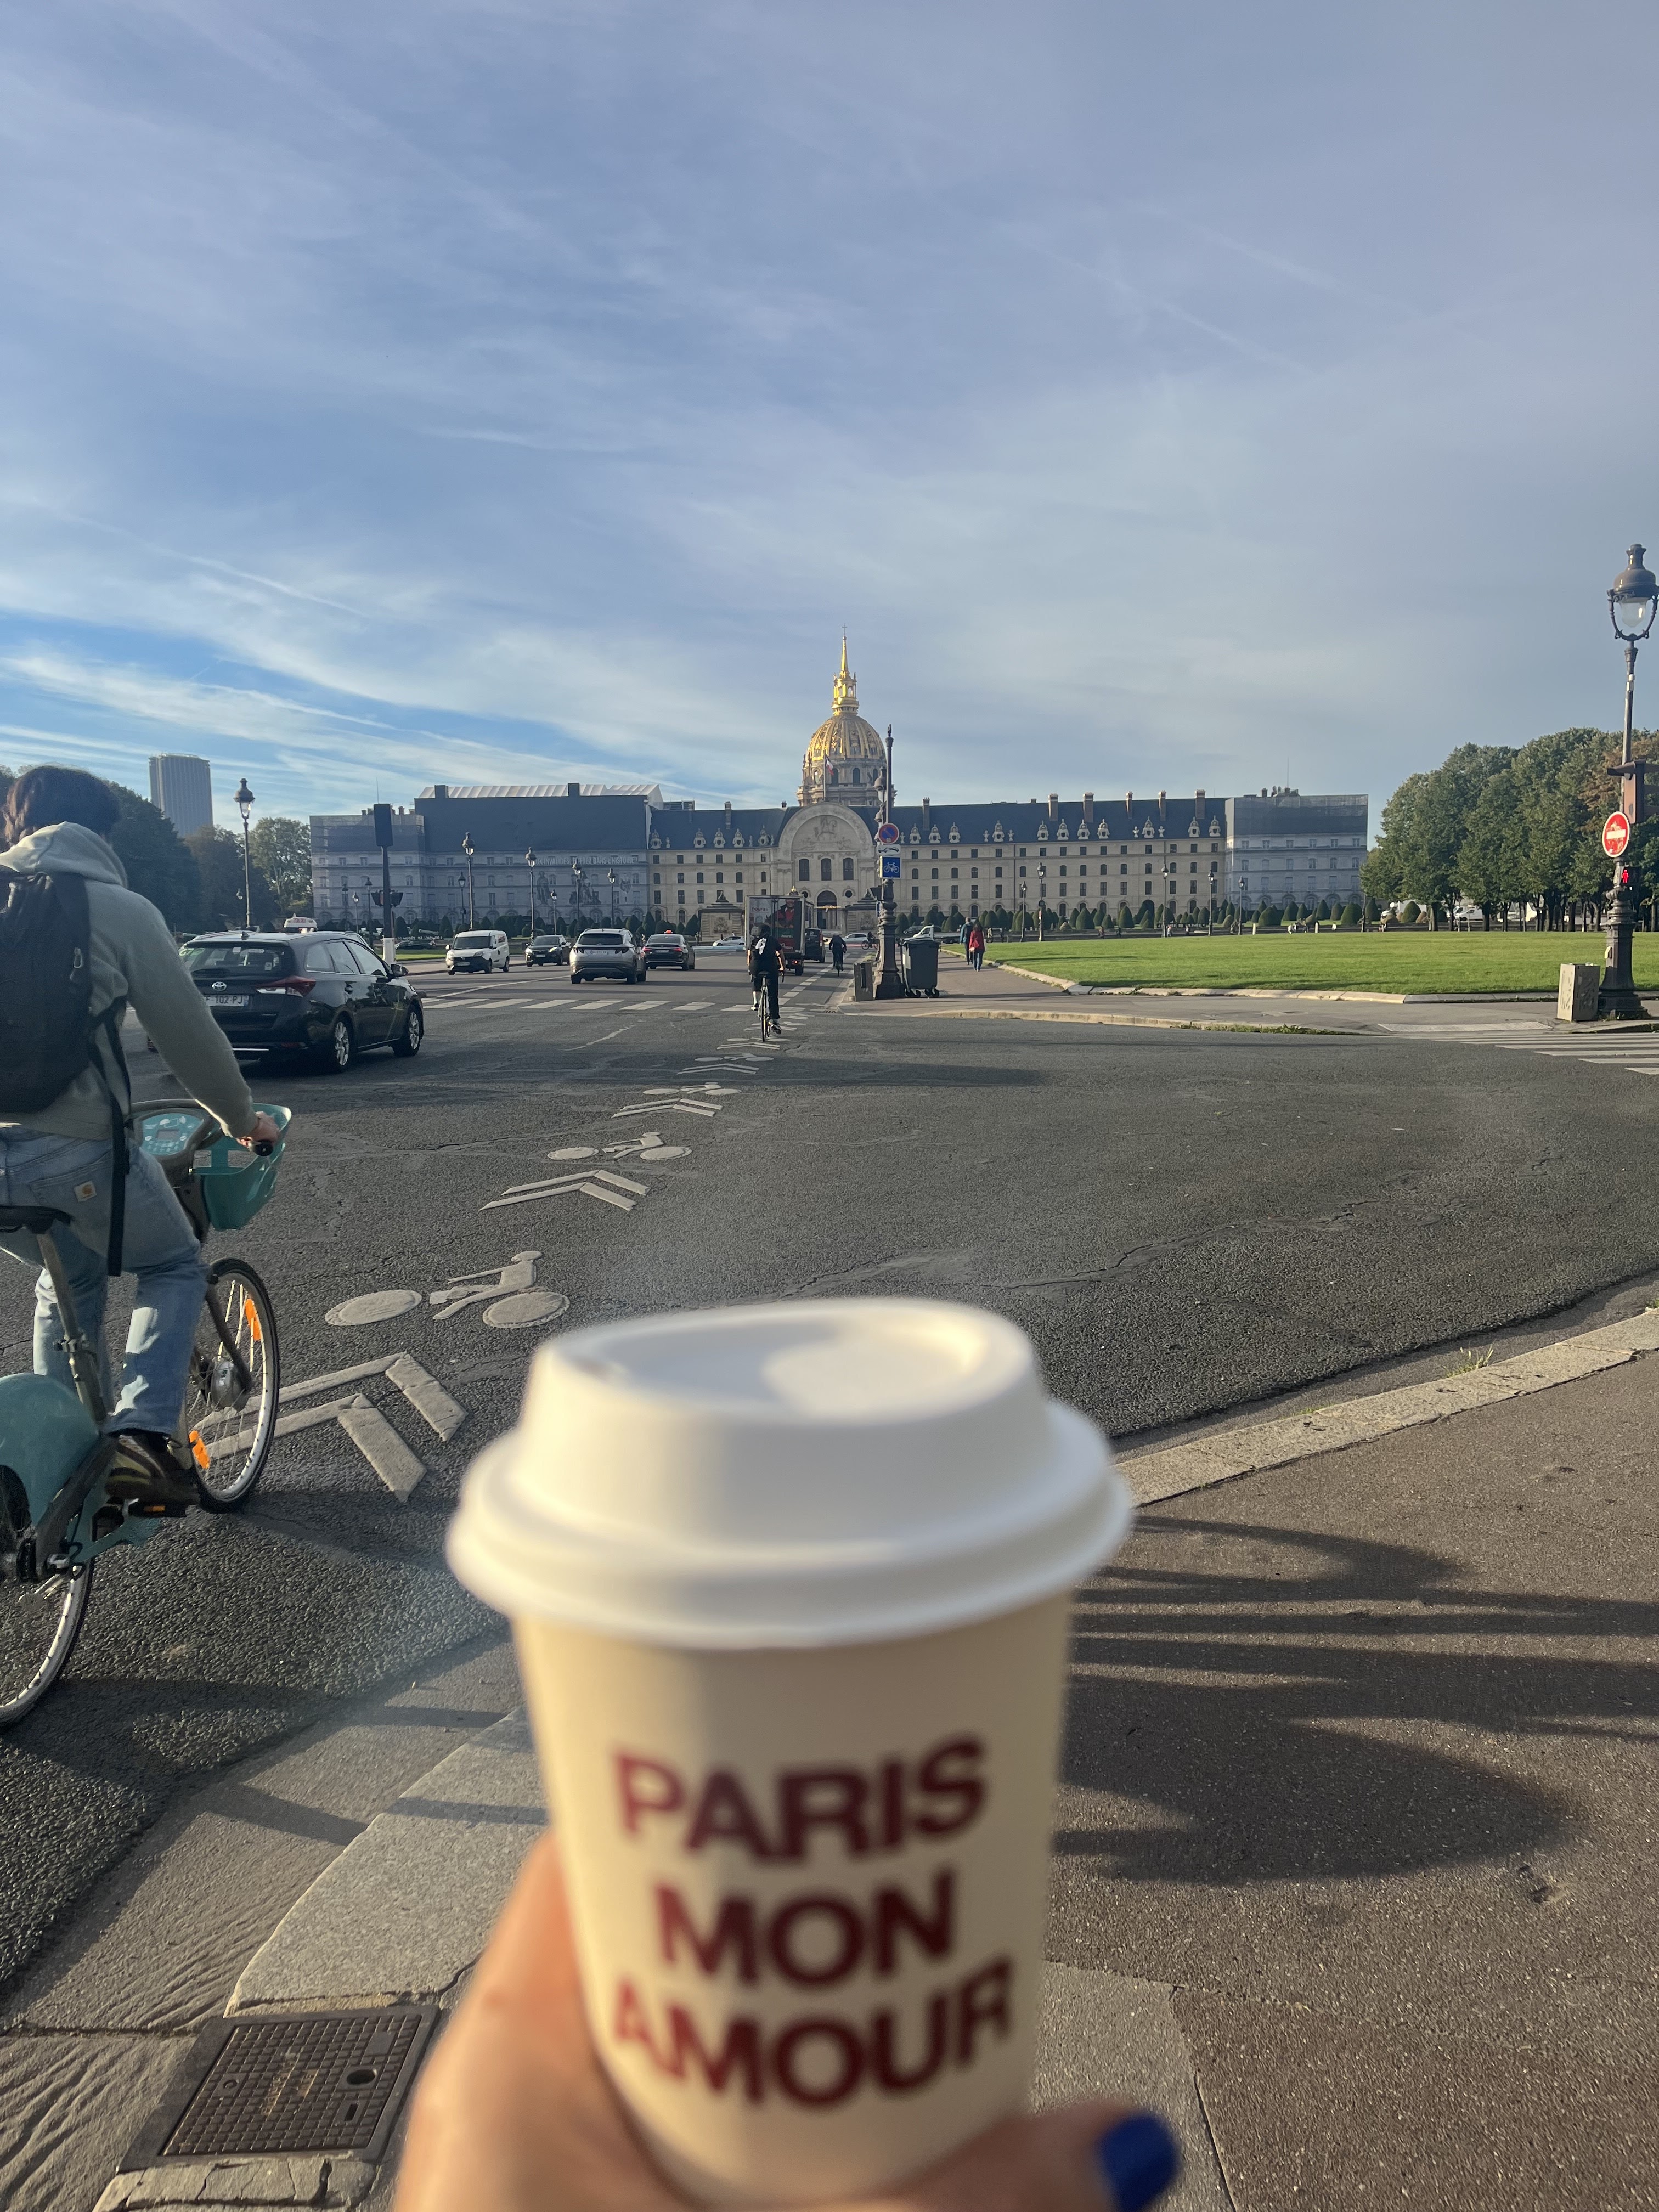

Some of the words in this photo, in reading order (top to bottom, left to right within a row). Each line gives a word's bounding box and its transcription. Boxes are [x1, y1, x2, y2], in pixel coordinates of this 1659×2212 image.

[612, 1731, 987, 1863] PARIS
[654, 1866, 954, 1988] MON
[614, 1955, 1013, 2109] AMOUR
